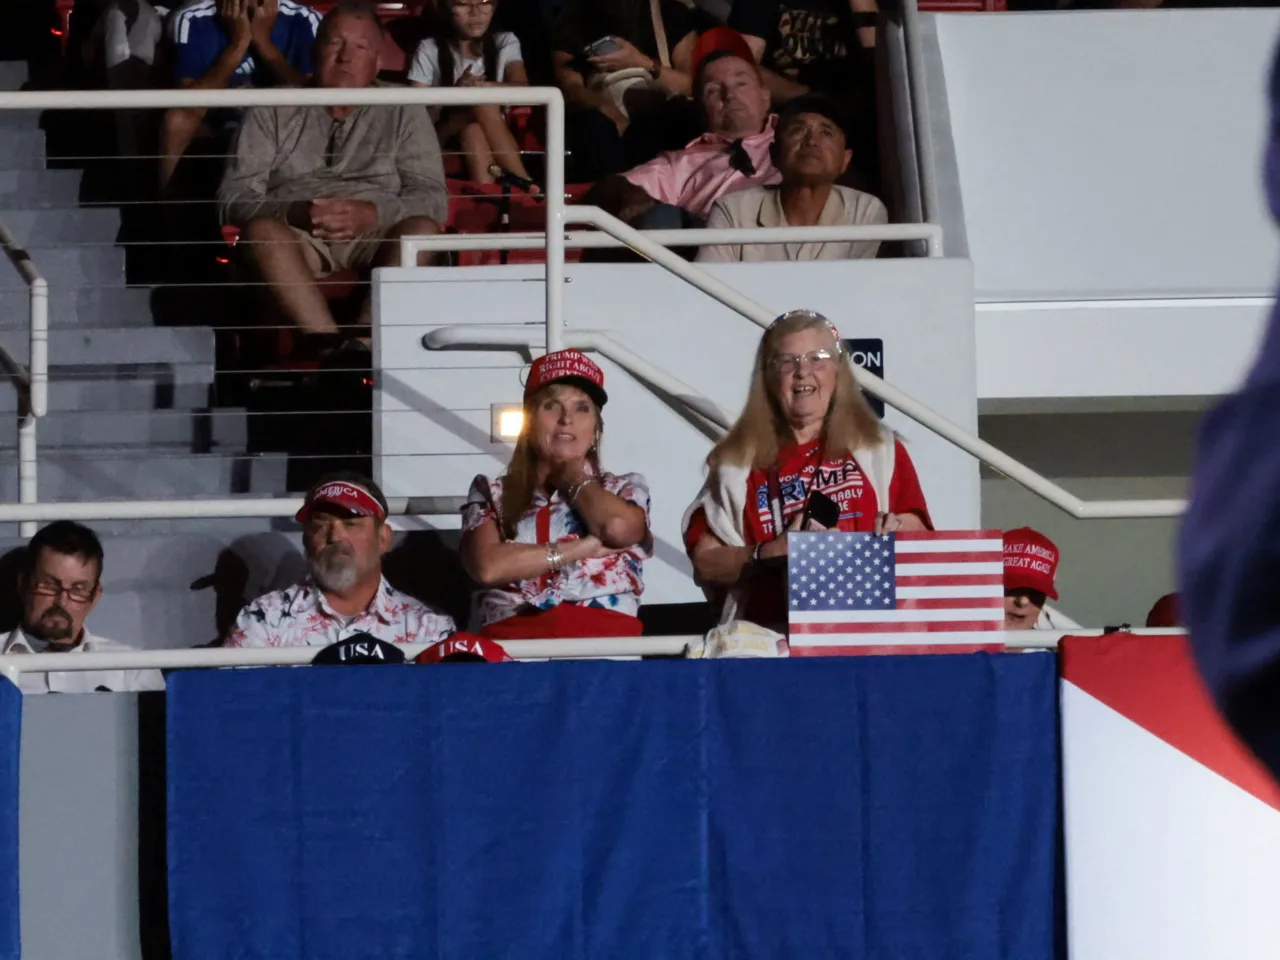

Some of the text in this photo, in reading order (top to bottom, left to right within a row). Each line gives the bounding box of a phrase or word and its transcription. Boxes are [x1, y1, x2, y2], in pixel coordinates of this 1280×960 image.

[546, 351, 581, 362] TRUMP
[540, 360, 601, 384] RIGHT ABOUT
[1003, 556, 1030, 568] GREAT
[1024, 544, 1055, 563] AMERICA
[339, 642, 384, 661] USA
[439, 639, 484, 657] USA
